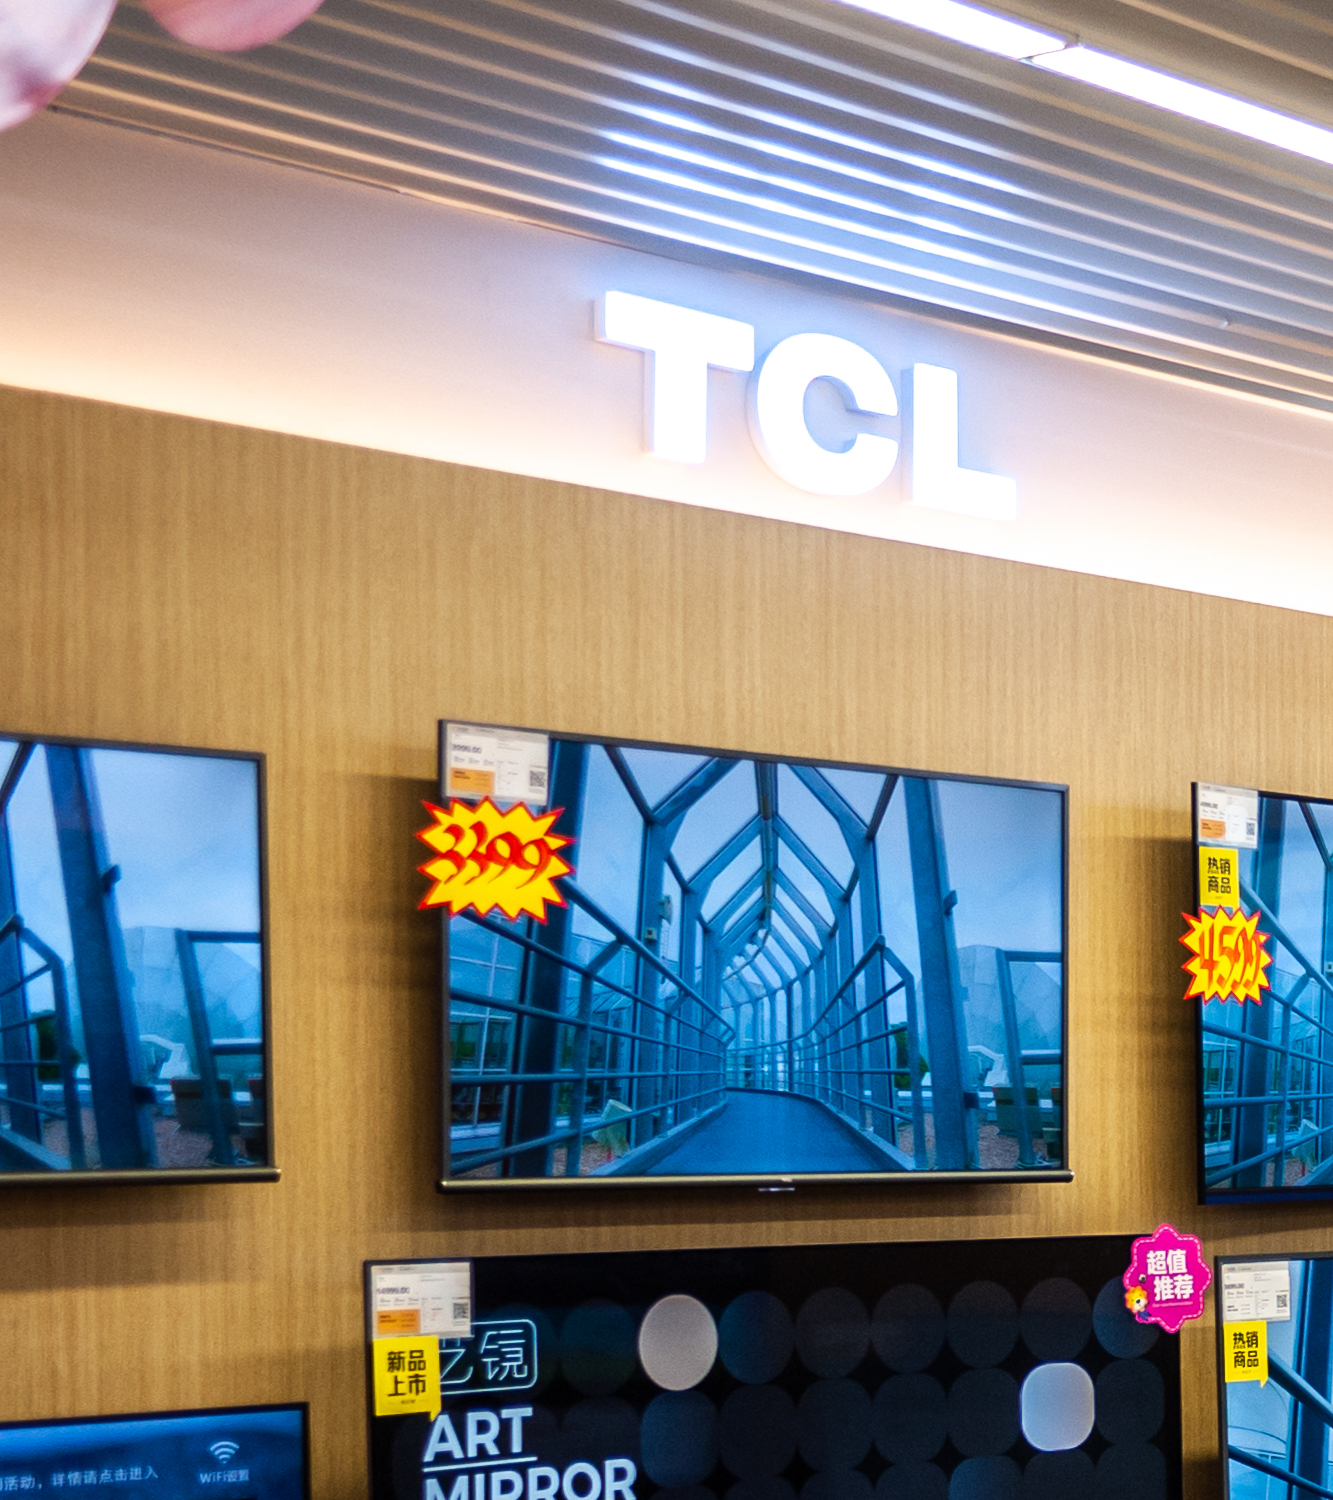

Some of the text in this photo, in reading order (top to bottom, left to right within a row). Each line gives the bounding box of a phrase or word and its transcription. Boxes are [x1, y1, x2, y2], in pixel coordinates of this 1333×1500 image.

[603, 291, 1016, 520] TCL
[442, 821, 551, 889] 3399
[1208, 857, 1230, 875] 热销
[1208, 876, 1231, 894] 商品
[1199, 922, 1261, 991] 4599
[1147, 1249, 1188, 1275] 超值
[1153, 1274, 1194, 1301] 推荐
[1233, 1331, 1258, 1350] 热销
[387, 1350, 426, 1373] 新品
[1234, 1351, 1258, 1368] 商品
[387, 1374, 426, 1397] 上市
[424, 1407, 533, 1462] ART
[0, 1466, 158, 1491] 活动,详情请点击进入
[200, 1469, 249, 1484] WiFi设置
